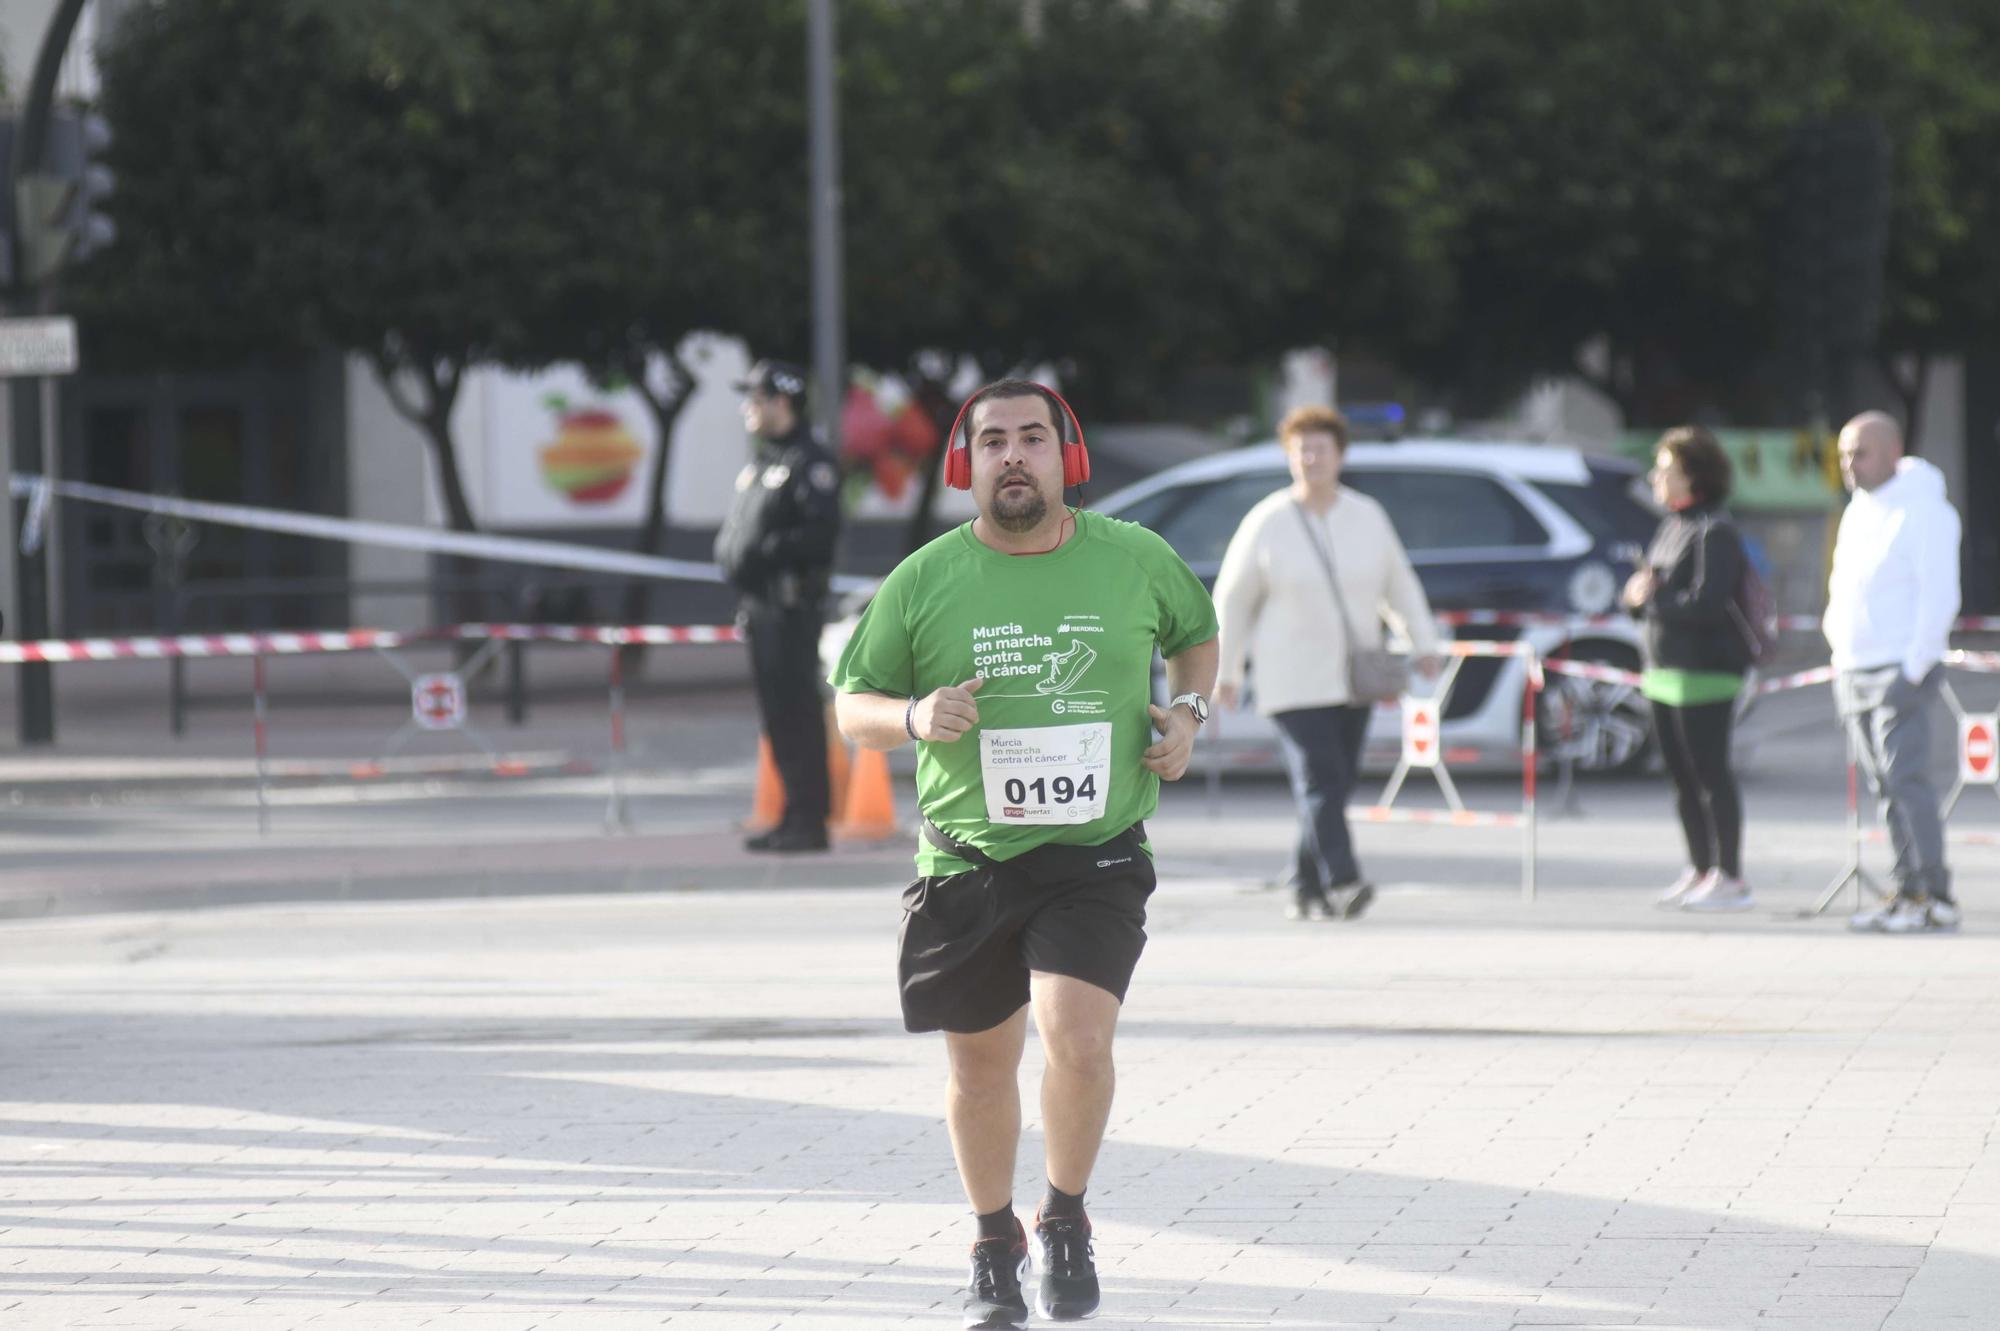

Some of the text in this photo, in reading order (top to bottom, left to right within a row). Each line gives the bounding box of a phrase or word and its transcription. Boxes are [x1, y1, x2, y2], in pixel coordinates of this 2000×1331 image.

[973, 622, 1023, 639] Murcia
[973, 634, 1053, 653] en marcha
[974, 651, 1022, 666] contra
[975, 663, 1043, 679] el cáncer
[991, 739, 1022, 747] Murcia
[1005, 747, 1041, 756] marcha
[991, 755, 1067, 765] contra el cáncer
[1004, 774, 1096, 805] 0194
